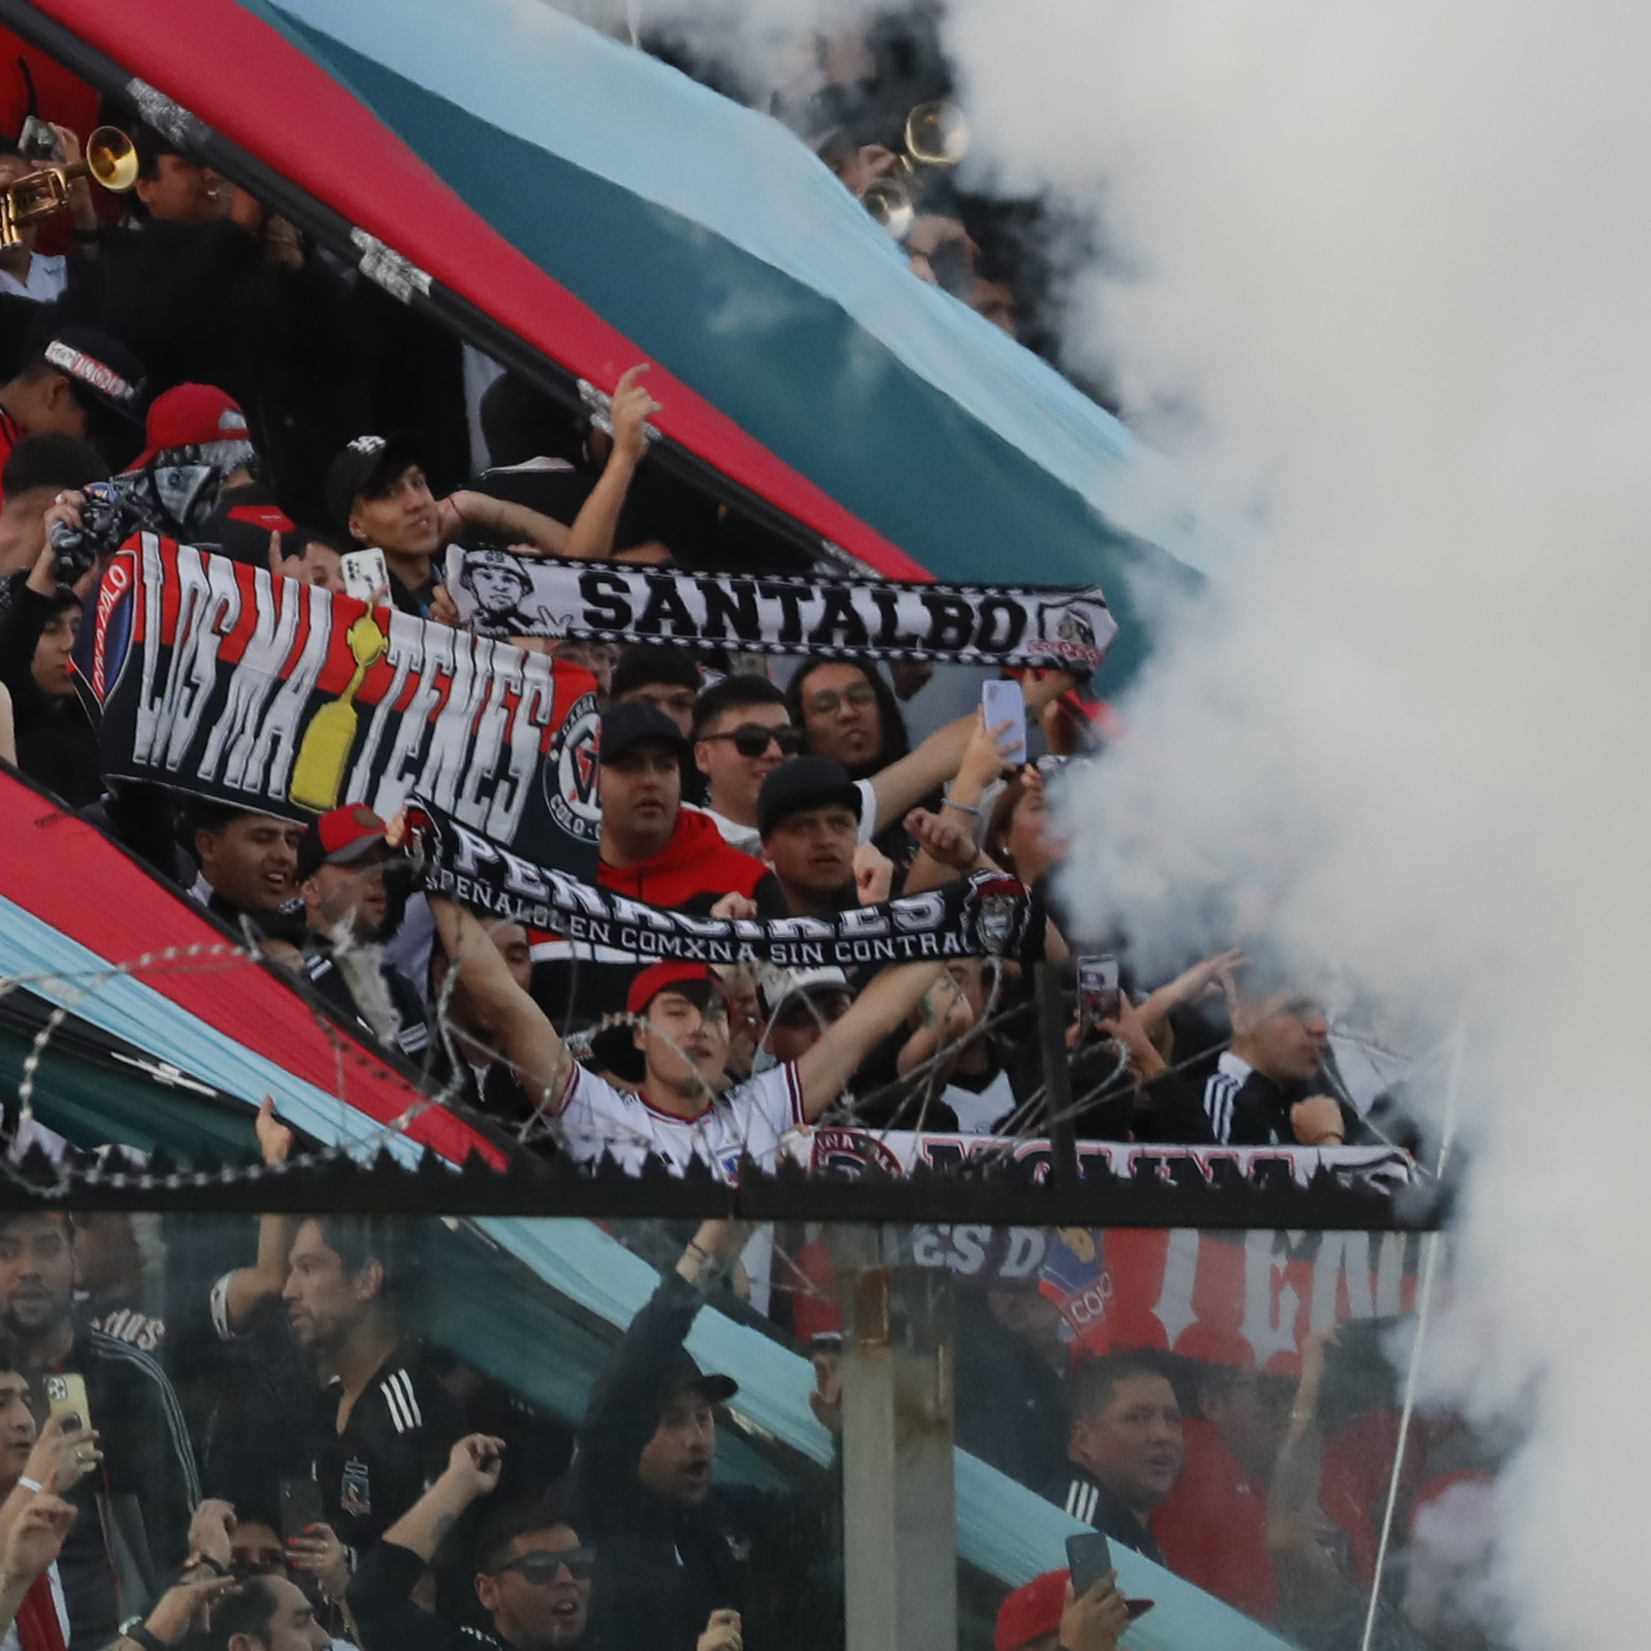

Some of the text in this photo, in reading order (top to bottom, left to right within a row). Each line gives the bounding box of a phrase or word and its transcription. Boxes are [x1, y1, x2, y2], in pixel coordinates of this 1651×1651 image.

[132, 530, 244, 772] LOS
[621, 927, 756, 963] COMXNA
[770, 941, 825, 965] SIN
